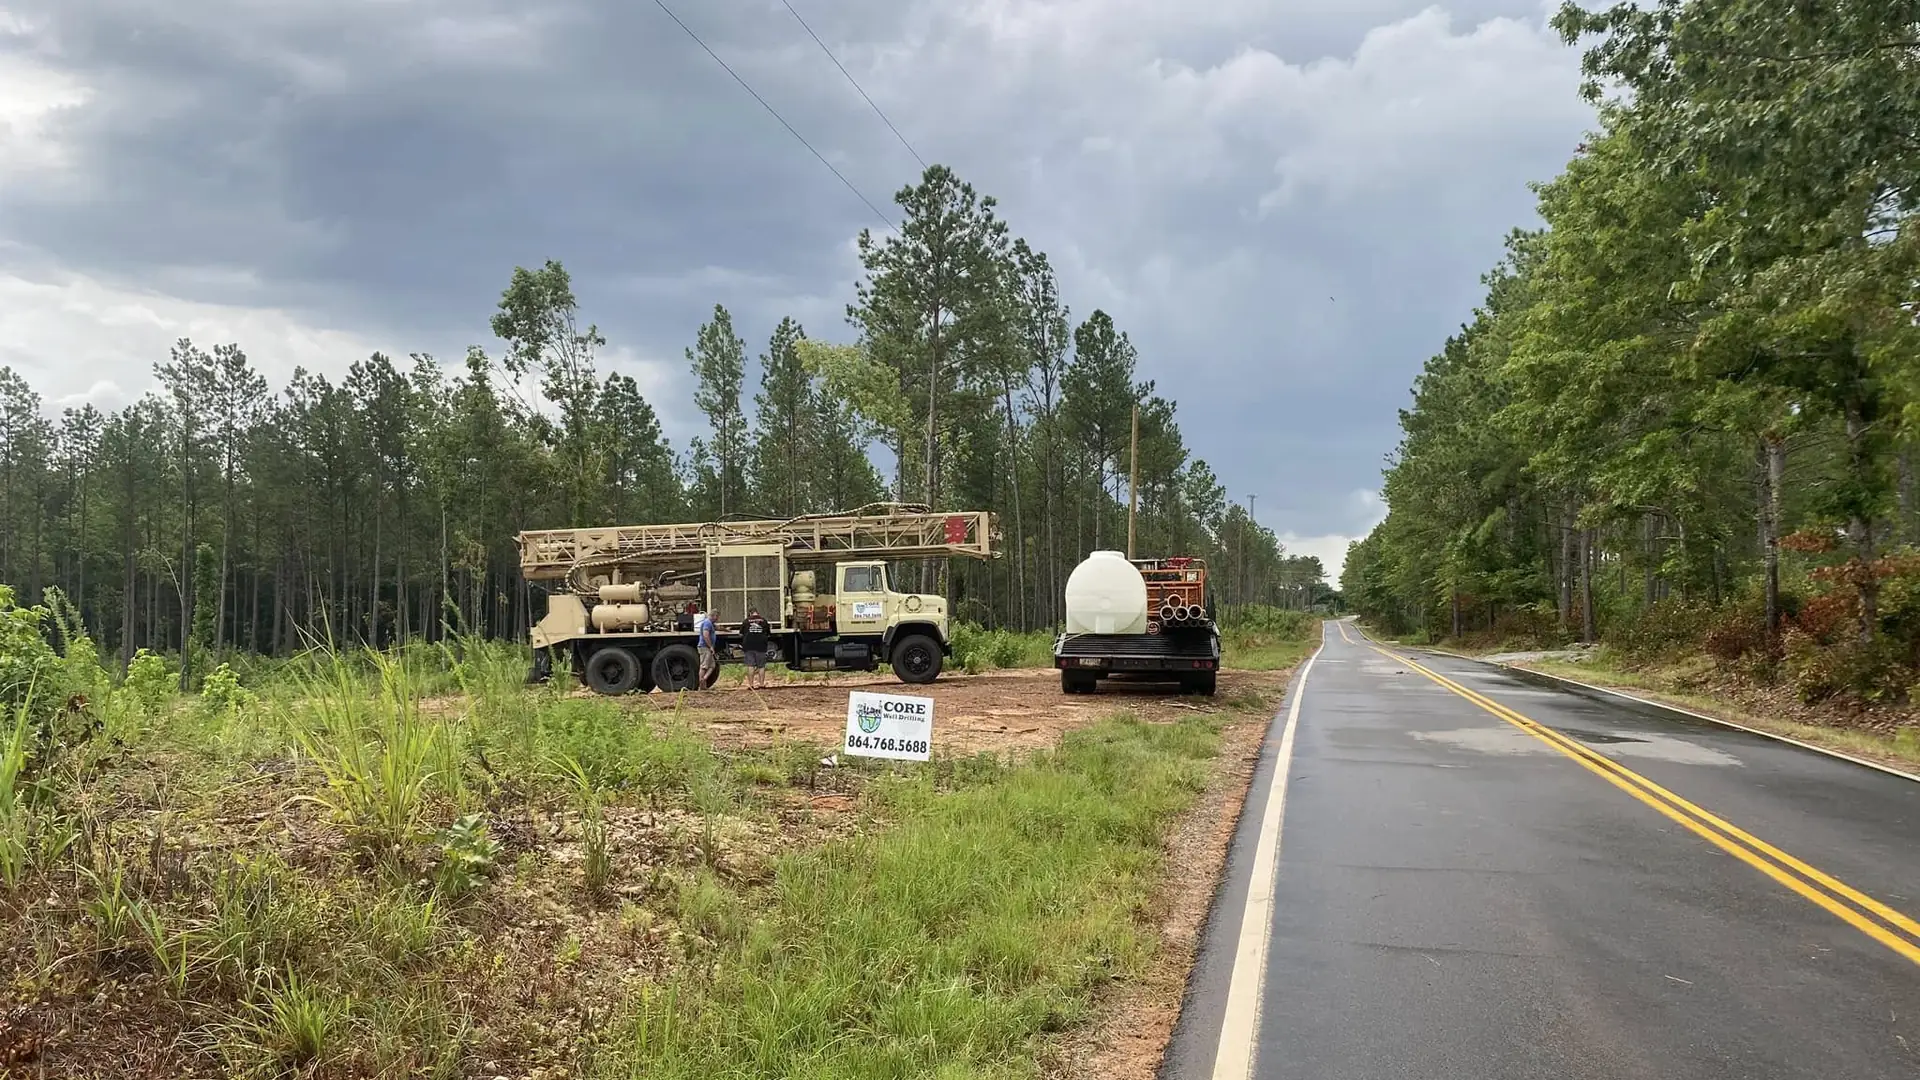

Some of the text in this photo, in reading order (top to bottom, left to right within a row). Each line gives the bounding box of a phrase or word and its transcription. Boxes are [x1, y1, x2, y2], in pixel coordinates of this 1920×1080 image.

[884, 701, 926, 714] CORE
[898, 714, 925, 722] Drilling
[848, 735, 927, 753] 864.768.5688
